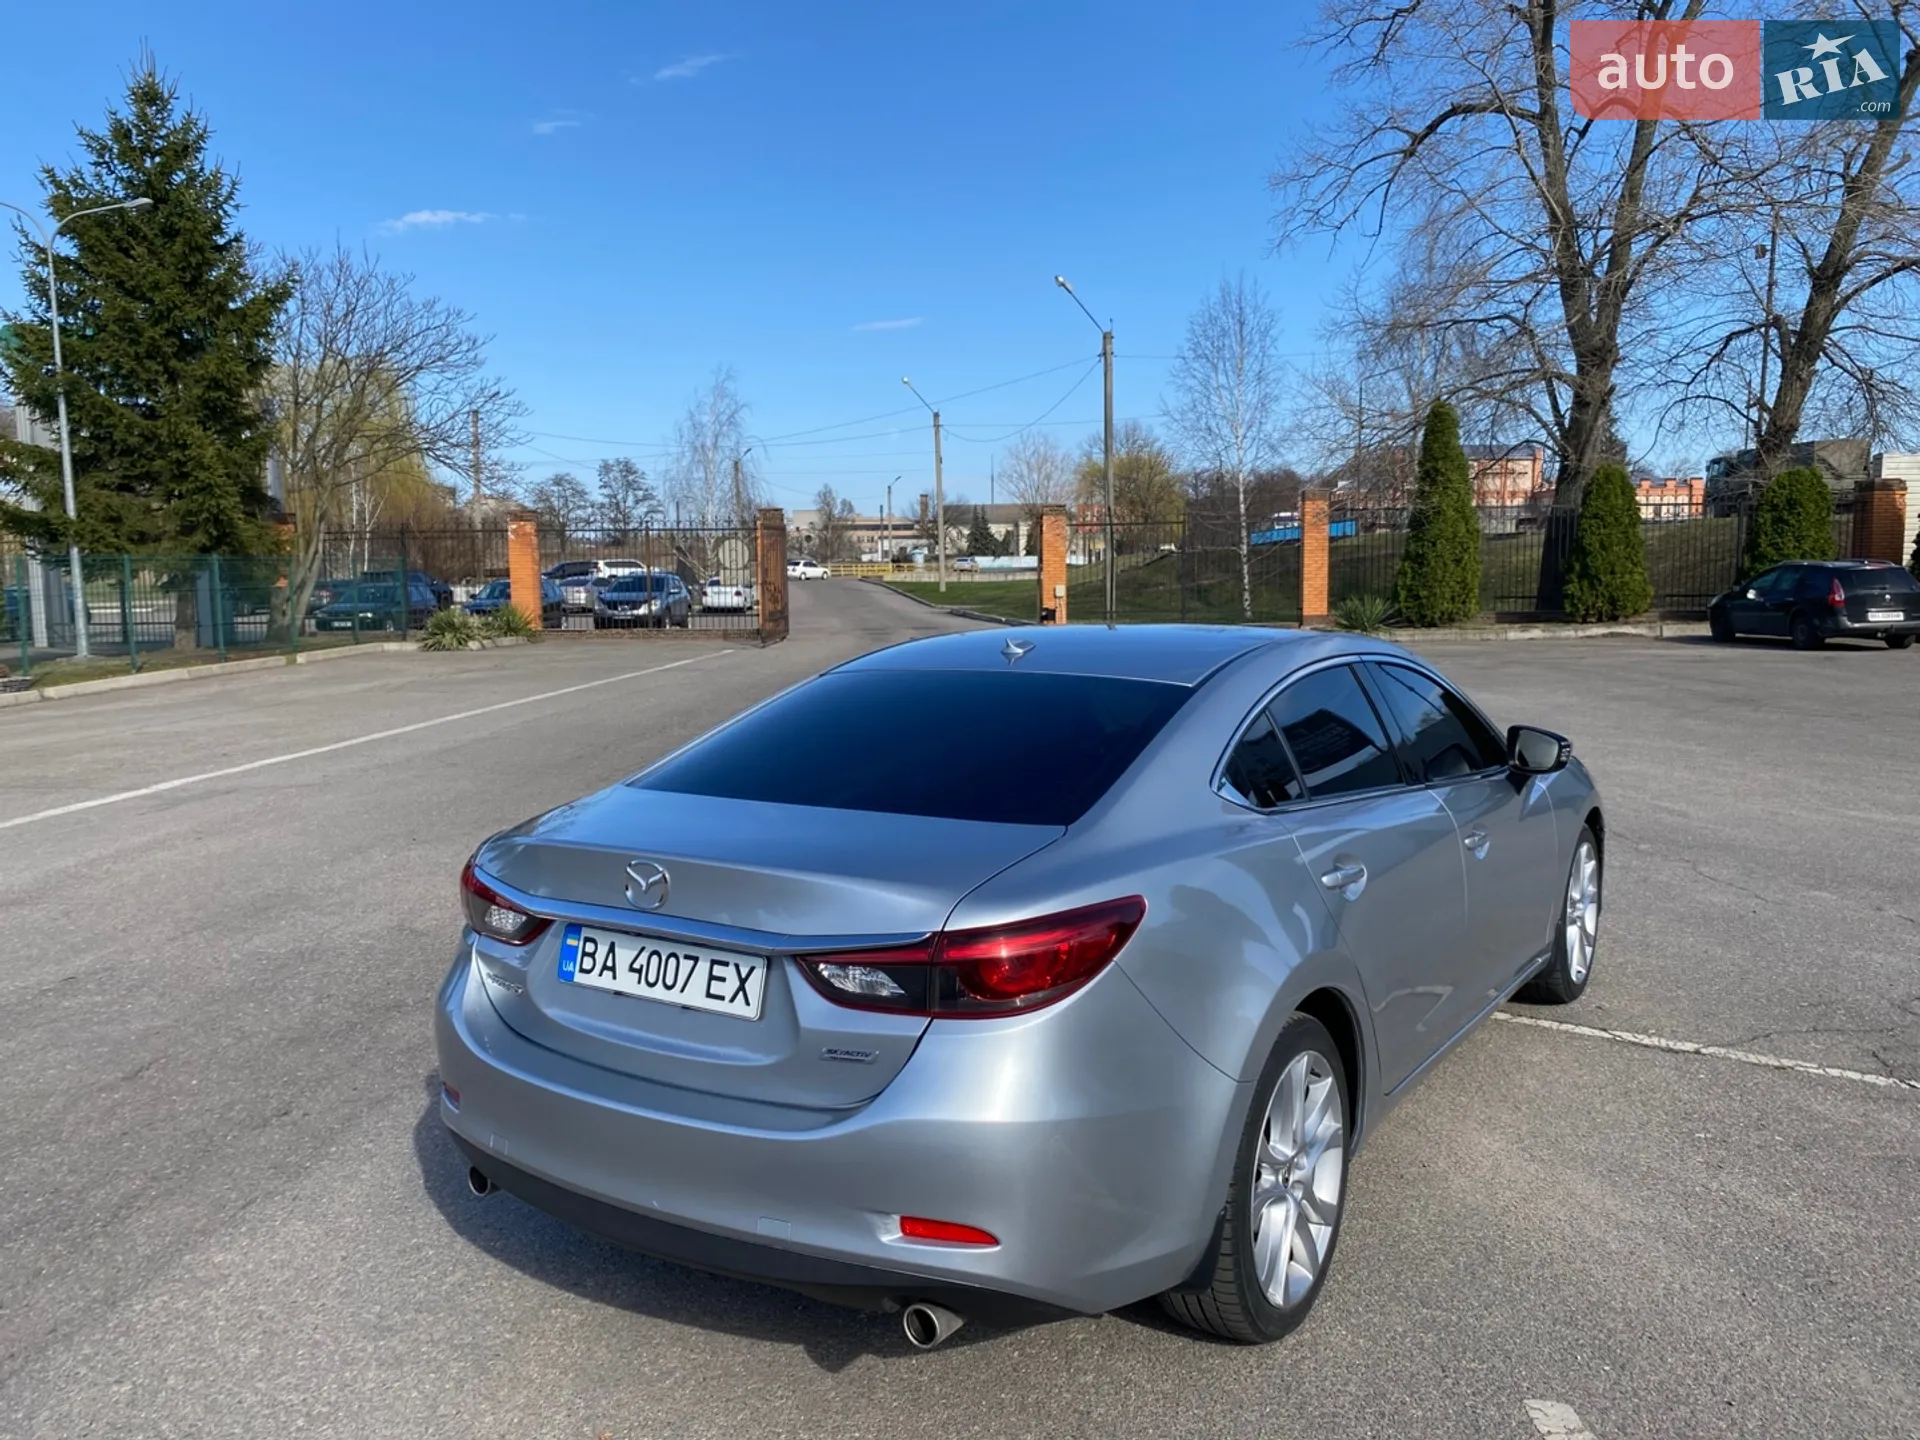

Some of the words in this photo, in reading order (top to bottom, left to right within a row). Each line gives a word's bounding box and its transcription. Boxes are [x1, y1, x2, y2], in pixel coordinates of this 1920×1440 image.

[562, 960, 574, 973] UA
[578, 936, 618, 980] BA
[628, 946, 700, 993] 4007
[705, 958, 756, 1007] EX
